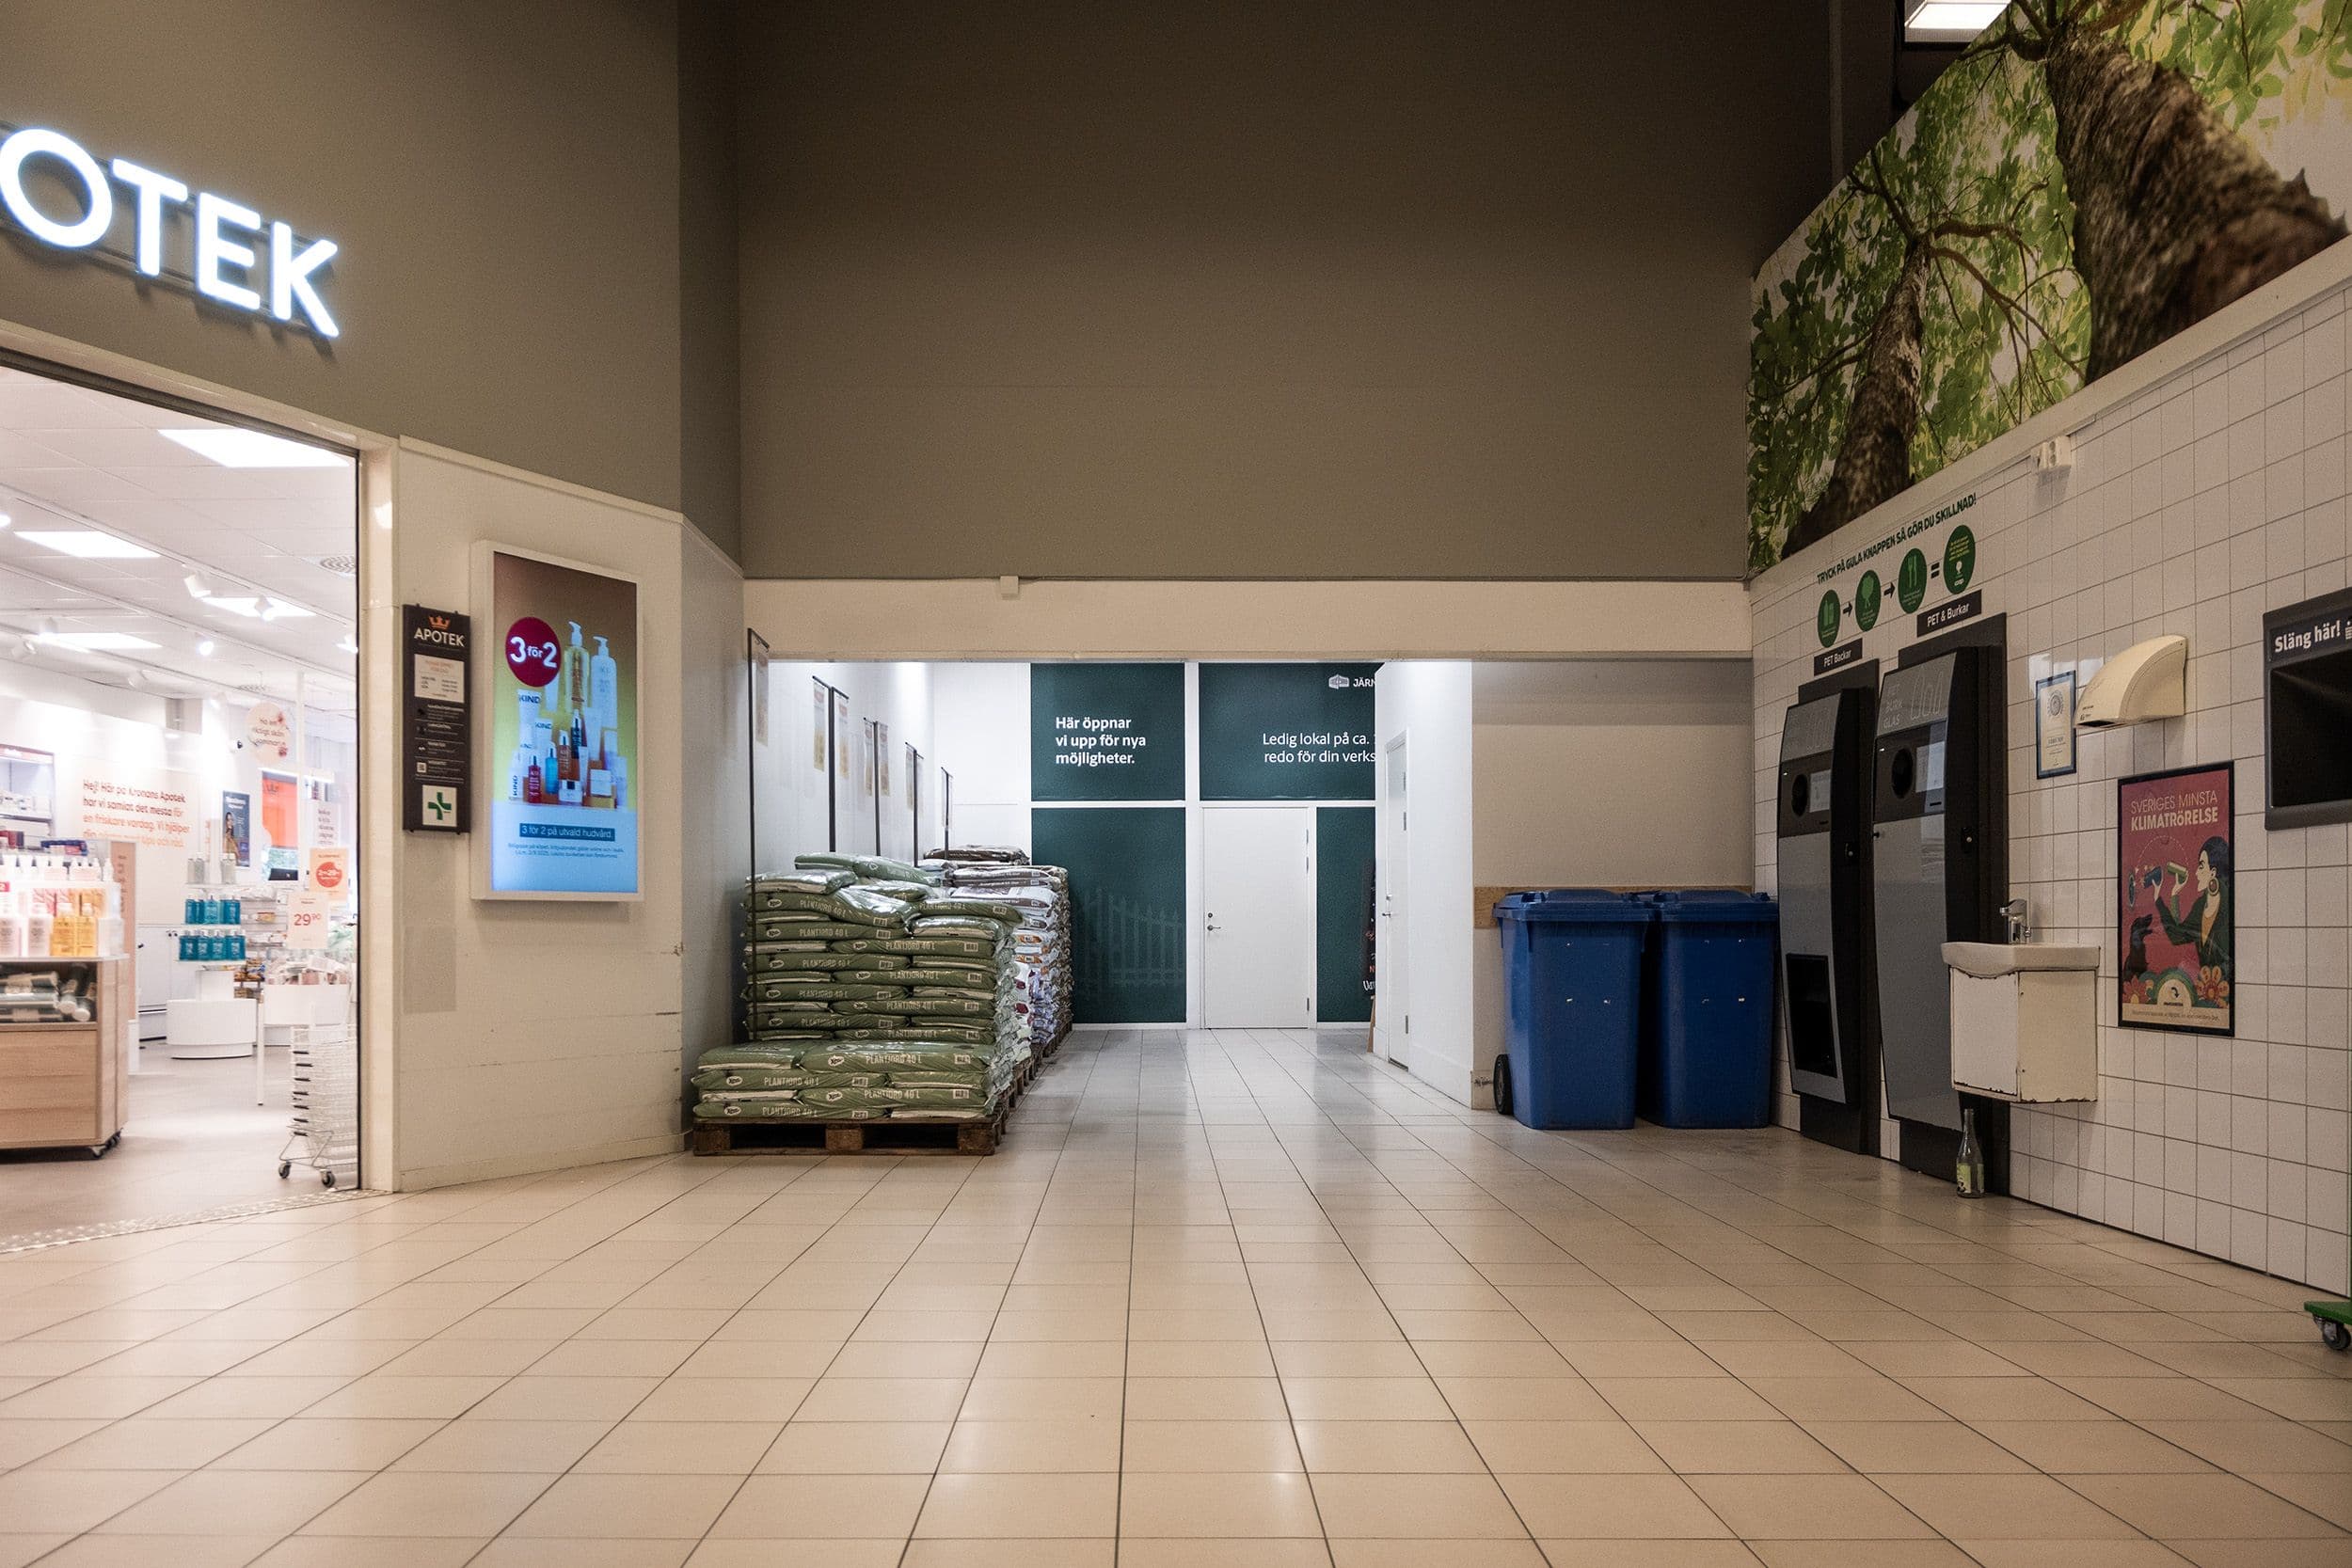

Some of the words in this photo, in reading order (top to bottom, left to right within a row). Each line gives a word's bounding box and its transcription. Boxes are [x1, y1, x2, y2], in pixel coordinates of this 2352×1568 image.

[0, 128, 340, 339] OTEK
[1817, 566, 1837, 584] TRYCK
[1836, 559, 1846, 575] PÅ
[1846, 552, 1862, 570] GULA
[1863, 535, 1896, 561] KNAPPEN
[1897, 527, 1906, 545] SÅ
[1907, 520, 1923, 538] GÖR
[1924, 515, 1934, 531] DU
[1935, 493, 1977, 524] SKILLNAD!
[1927, 612, 1940, 627] PET
[1941, 610, 1947, 622] &
[1947, 603, 1969, 619] Burkar
[414, 627, 465, 647] APOTEK
[2275, 632, 2312, 653] Släng
[2314, 620, 2341, 642] här!
[510, 636, 526, 663] 3
[527, 645, 543, 657] för
[543, 641, 558, 669] 2
[1823, 655, 1834, 668] PET
[1835, 650, 1851, 663] Backar
[1056, 717, 1080, 729] Här
[1083, 717, 1132, 732] öppnar
[1056, 735, 1068, 746] vi
[1071, 736, 1097, 749] upp
[1100, 734, 1120, 746] för
[1122, 736, 1146, 749] nya
[1263, 733, 1297, 748] Ledig
[1300, 733, 1330, 745] lokal
[1334, 732, 1349, 747] på
[1352, 735, 1370, 745] ca.
[1056, 752, 1135, 767] möjligheter.
[1264, 751, 1295, 762] redo
[1298, 750, 1316, 762] för
[1319, 751, 1339, 762] din
[1343, 750, 1375, 762] verks
[2131, 796, 2175, 815] SVERIGES
[2179, 790, 2218, 808] MINSTA
[521, 825, 527, 834] 3
[541, 827, 546, 835] 2
[548, 827, 557, 836] på
[559, 828, 580, 836] utvald
[294, 913, 311, 927] 29
[800, 928, 834, 937] PLANTJORD
[886, 941, 920, 950] PLANTJORD
[890, 970, 924, 979] PLANTJORD
[886, 1001, 921, 1010] PLANTJORD
[866, 1053, 906, 1065] PLANTJORD
[764, 1077, 803, 1086] PLANTJORD
[864, 1089, 902, 1099] PLANTJORD
